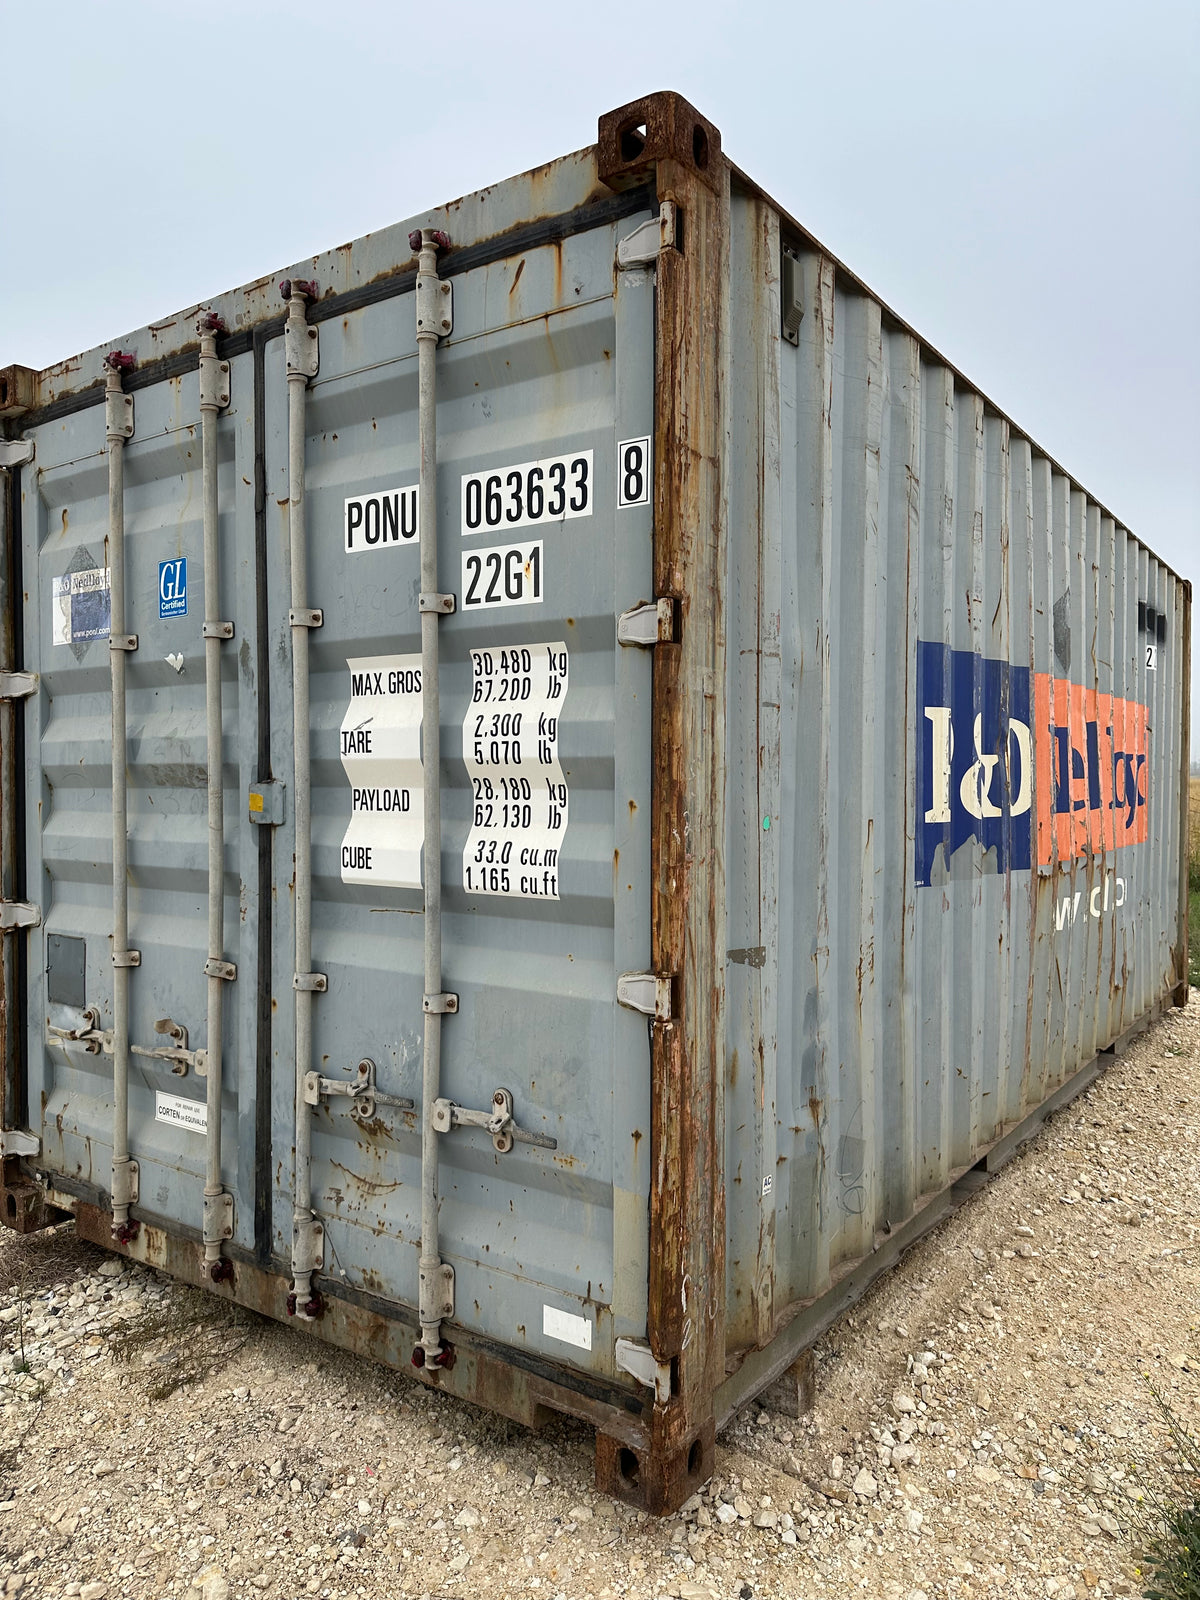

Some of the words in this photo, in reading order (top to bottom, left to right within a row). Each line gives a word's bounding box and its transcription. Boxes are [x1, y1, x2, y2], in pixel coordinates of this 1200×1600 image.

[347, 490, 417, 549] PONU
[465, 458, 589, 529] 063633
[624, 445, 643, 502] 8
[160, 561, 186, 601] GL
[465, 546, 540, 606] 22G1
[161, 598, 185, 611] Certified
[473, 649, 532, 676] 30,480
[547, 646, 567, 677] kg
[352, 673, 386, 697] MAX.
[388, 670, 422, 694] GROS
[473, 676, 531, 702] 67,200
[546, 675, 561, 699] lb
[474, 713, 522, 738] 2,300
[538, 712, 557, 742] kg
[342, 730, 372, 754] TARE
[474, 740, 522, 765] 5,070
[538, 740, 553, 765] lb
[353, 789, 410, 812] PAYLOAD
[472, 777, 531, 800] 28,180
[545, 777, 567, 808] kg
[474, 804, 531, 828] 62,130
[547, 805, 562, 829] lb
[342, 846, 372, 870] CUBE
[474, 840, 513, 864] 33.0
[520, 847, 557, 867] cu.m
[520, 871, 557, 896] cu.ft
[159, 1105, 180, 1119] CORTEN
[185, 1115, 207, 1127] EQUIVALEN
